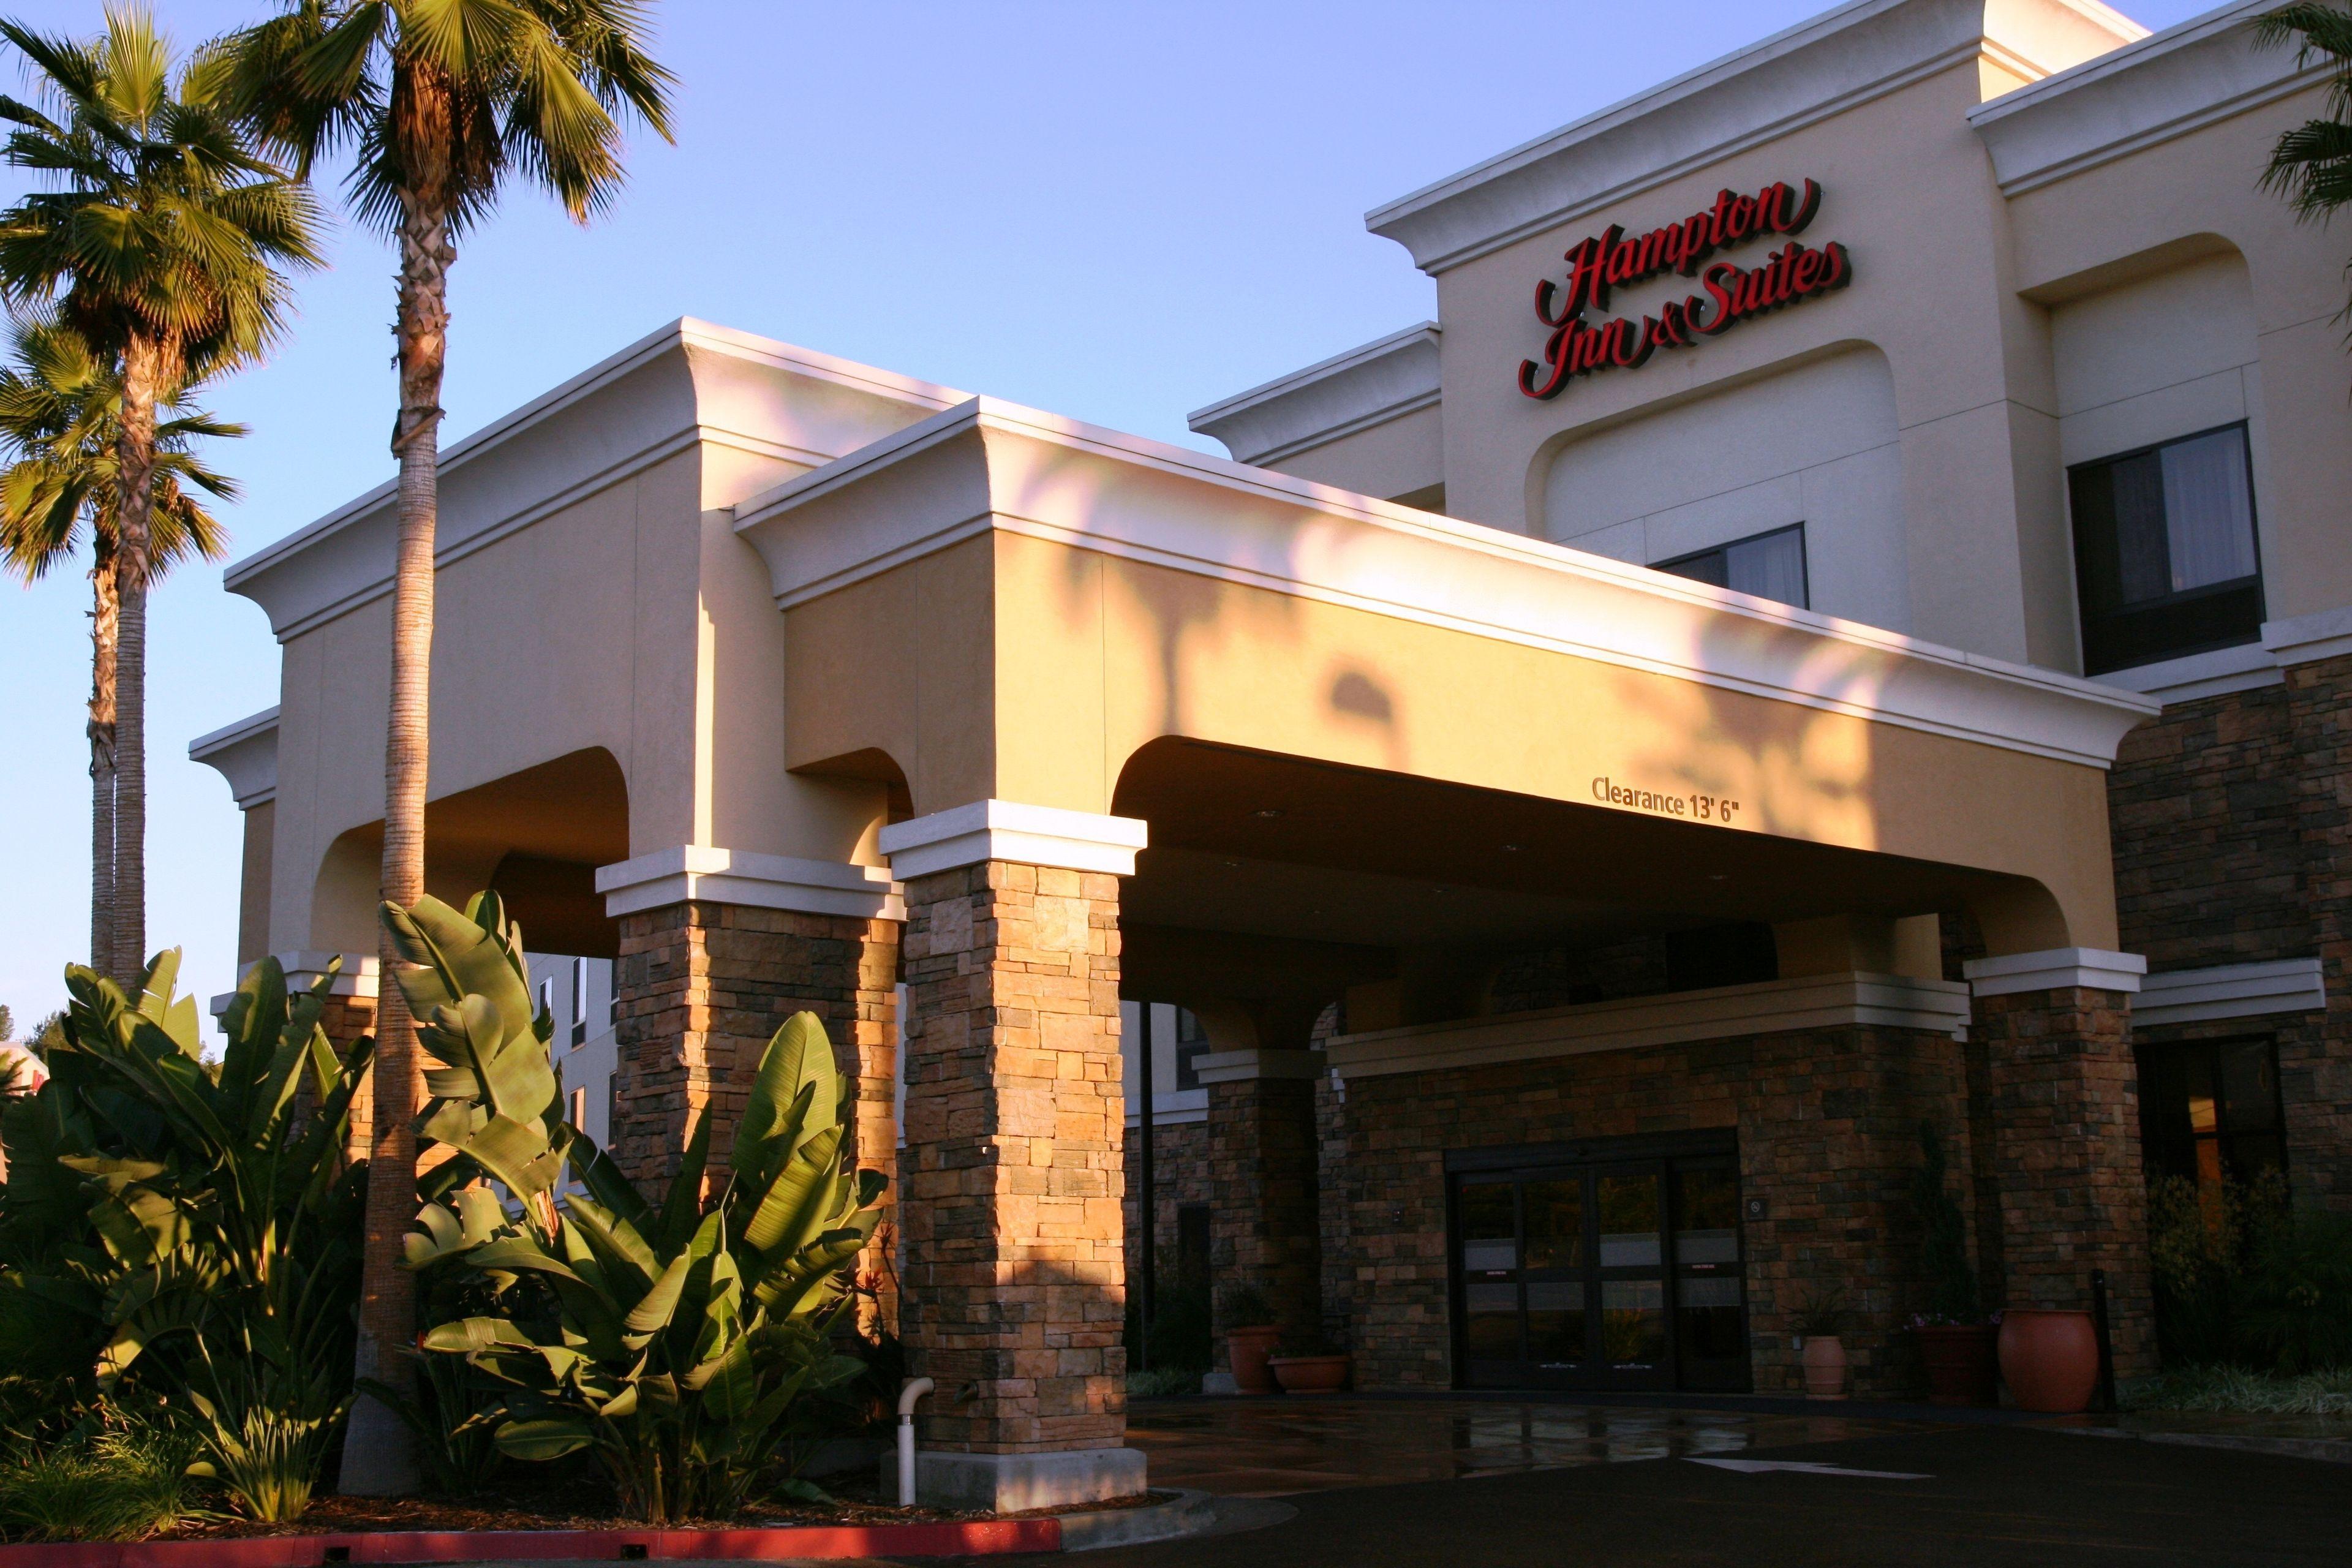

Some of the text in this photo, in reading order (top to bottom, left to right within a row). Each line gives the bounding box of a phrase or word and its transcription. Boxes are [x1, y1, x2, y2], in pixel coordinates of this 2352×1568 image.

[1518, 241, 1852, 401] Inn & Suites
[1535, 177, 1822, 328] Hampton
[1592, 777, 1740, 822] Clearance 13' 6"
